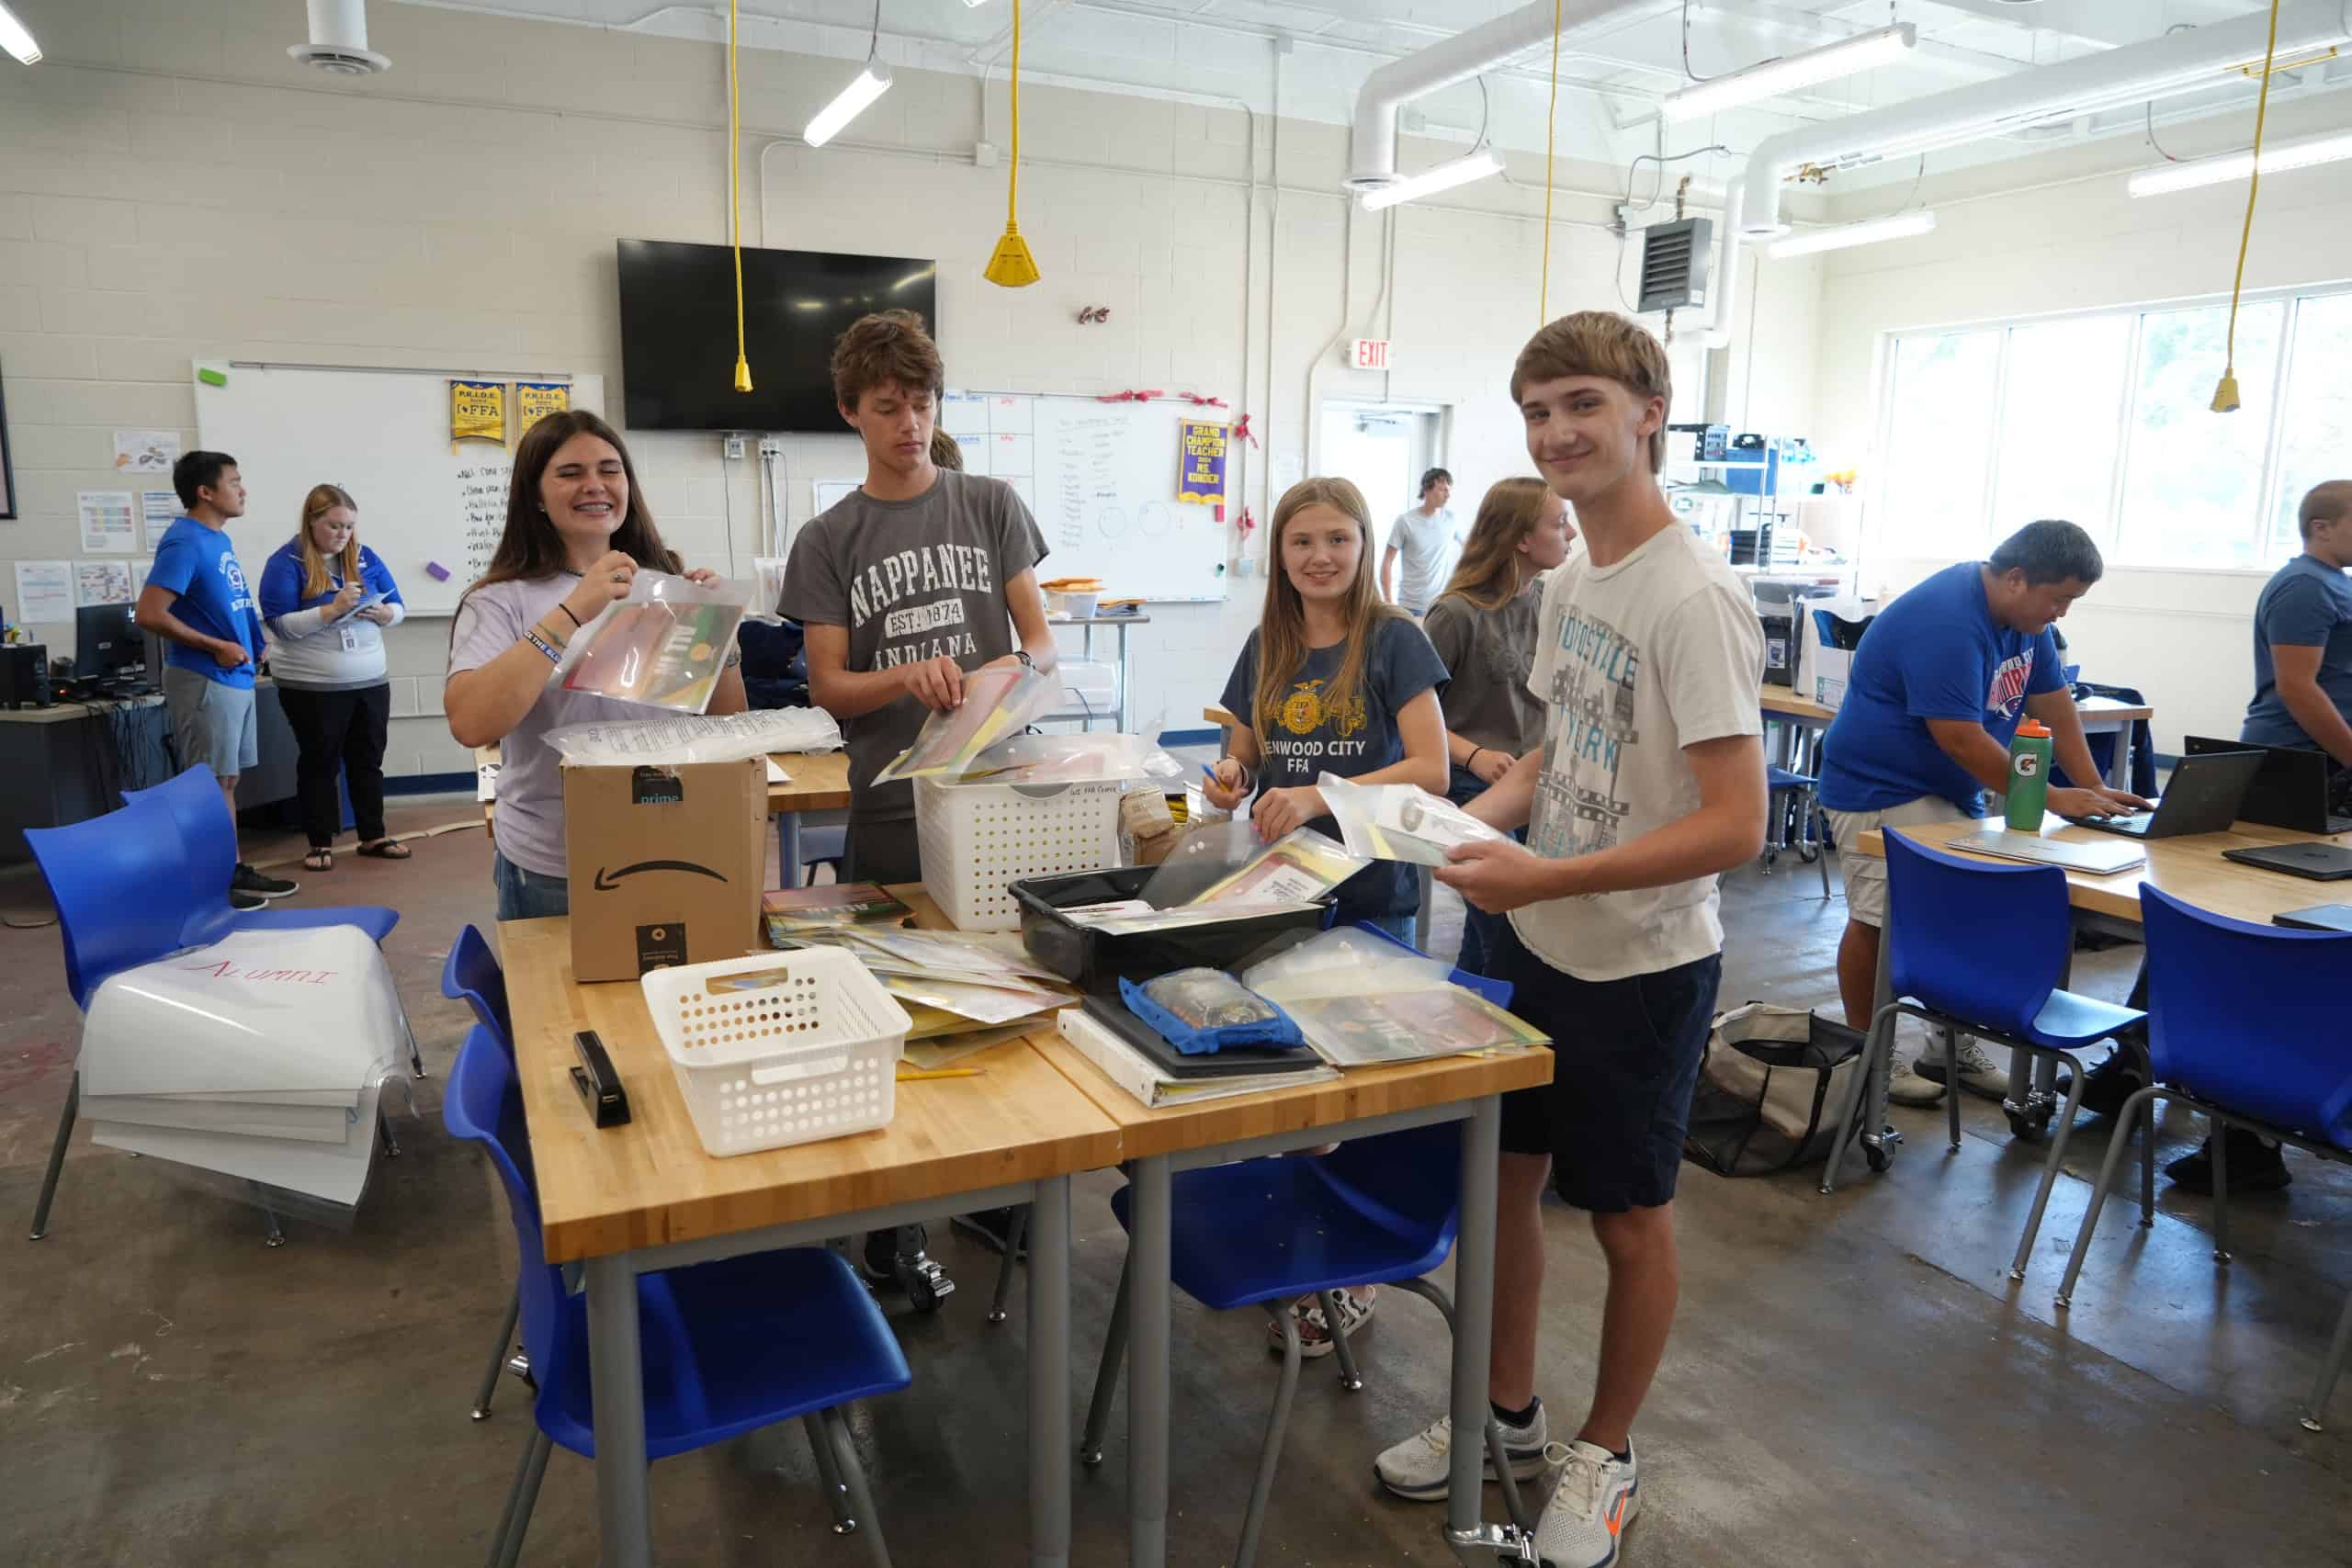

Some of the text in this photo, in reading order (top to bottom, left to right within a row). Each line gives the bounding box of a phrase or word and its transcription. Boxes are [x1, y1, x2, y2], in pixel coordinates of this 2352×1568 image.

[1360, 341, 1388, 367] EXIT
[469, 405, 499, 416] FFA
[1193, 425, 1220, 436] GRAND
[1186, 435, 1226, 448] CHAMPION
[1187, 447, 1225, 457] TEACHER
[851, 543, 992, 628] NAPPANEE
[890, 602, 961, 634] EST. 1874
[875, 632, 978, 671] INDIANA
[1265, 740, 1366, 756] ENWOOD CITY
[1287, 758, 1309, 773] FFA
[2014, 752, 2037, 777] G
[641, 794, 678, 805] prime
